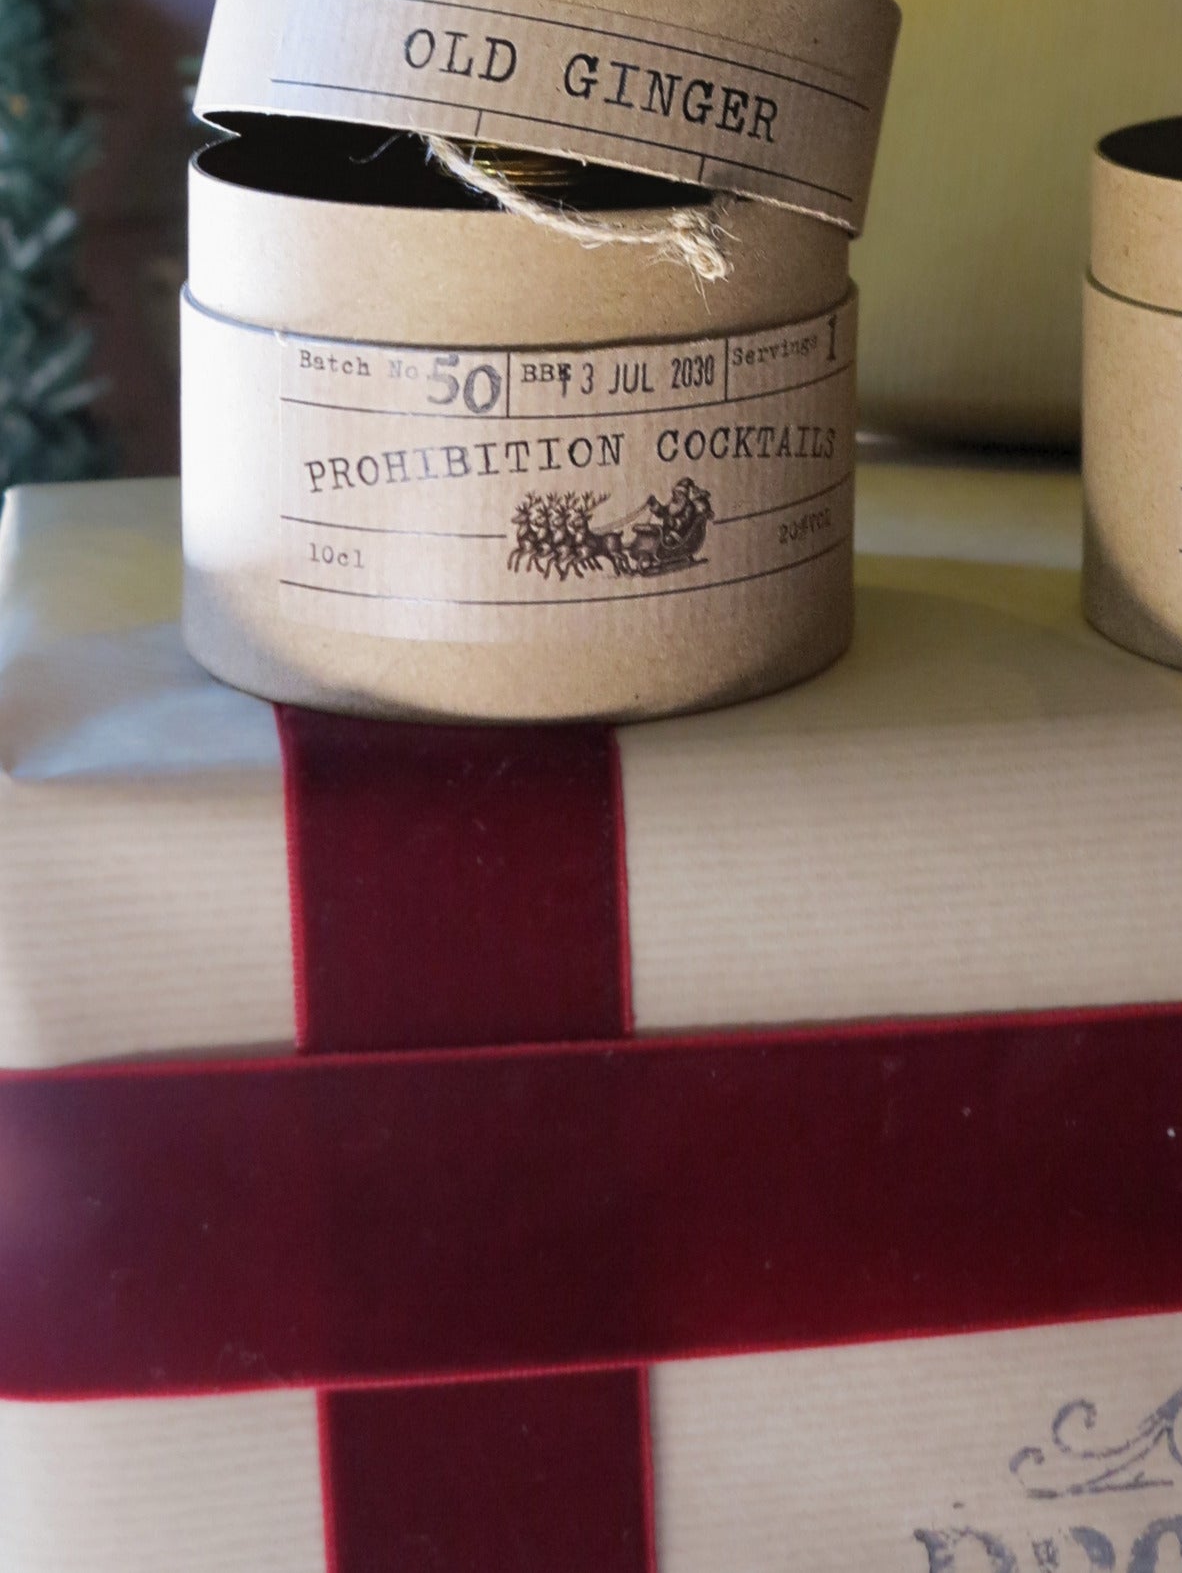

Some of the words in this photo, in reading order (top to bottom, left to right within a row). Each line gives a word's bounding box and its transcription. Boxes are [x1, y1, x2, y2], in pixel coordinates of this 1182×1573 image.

[403, 28, 518, 83] OLD
[563, 52, 779, 143] GINGER
[298, 349, 372, 377] Batch
[427, 353, 502, 415] 50
[608, 362, 655, 395] JUL
[670, 353, 716, 390] 2030
[304, 432, 626, 494] PROHIBITION
[656, 424, 838, 463] COCKTAILS
[308, 541, 366, 571] 10cl
